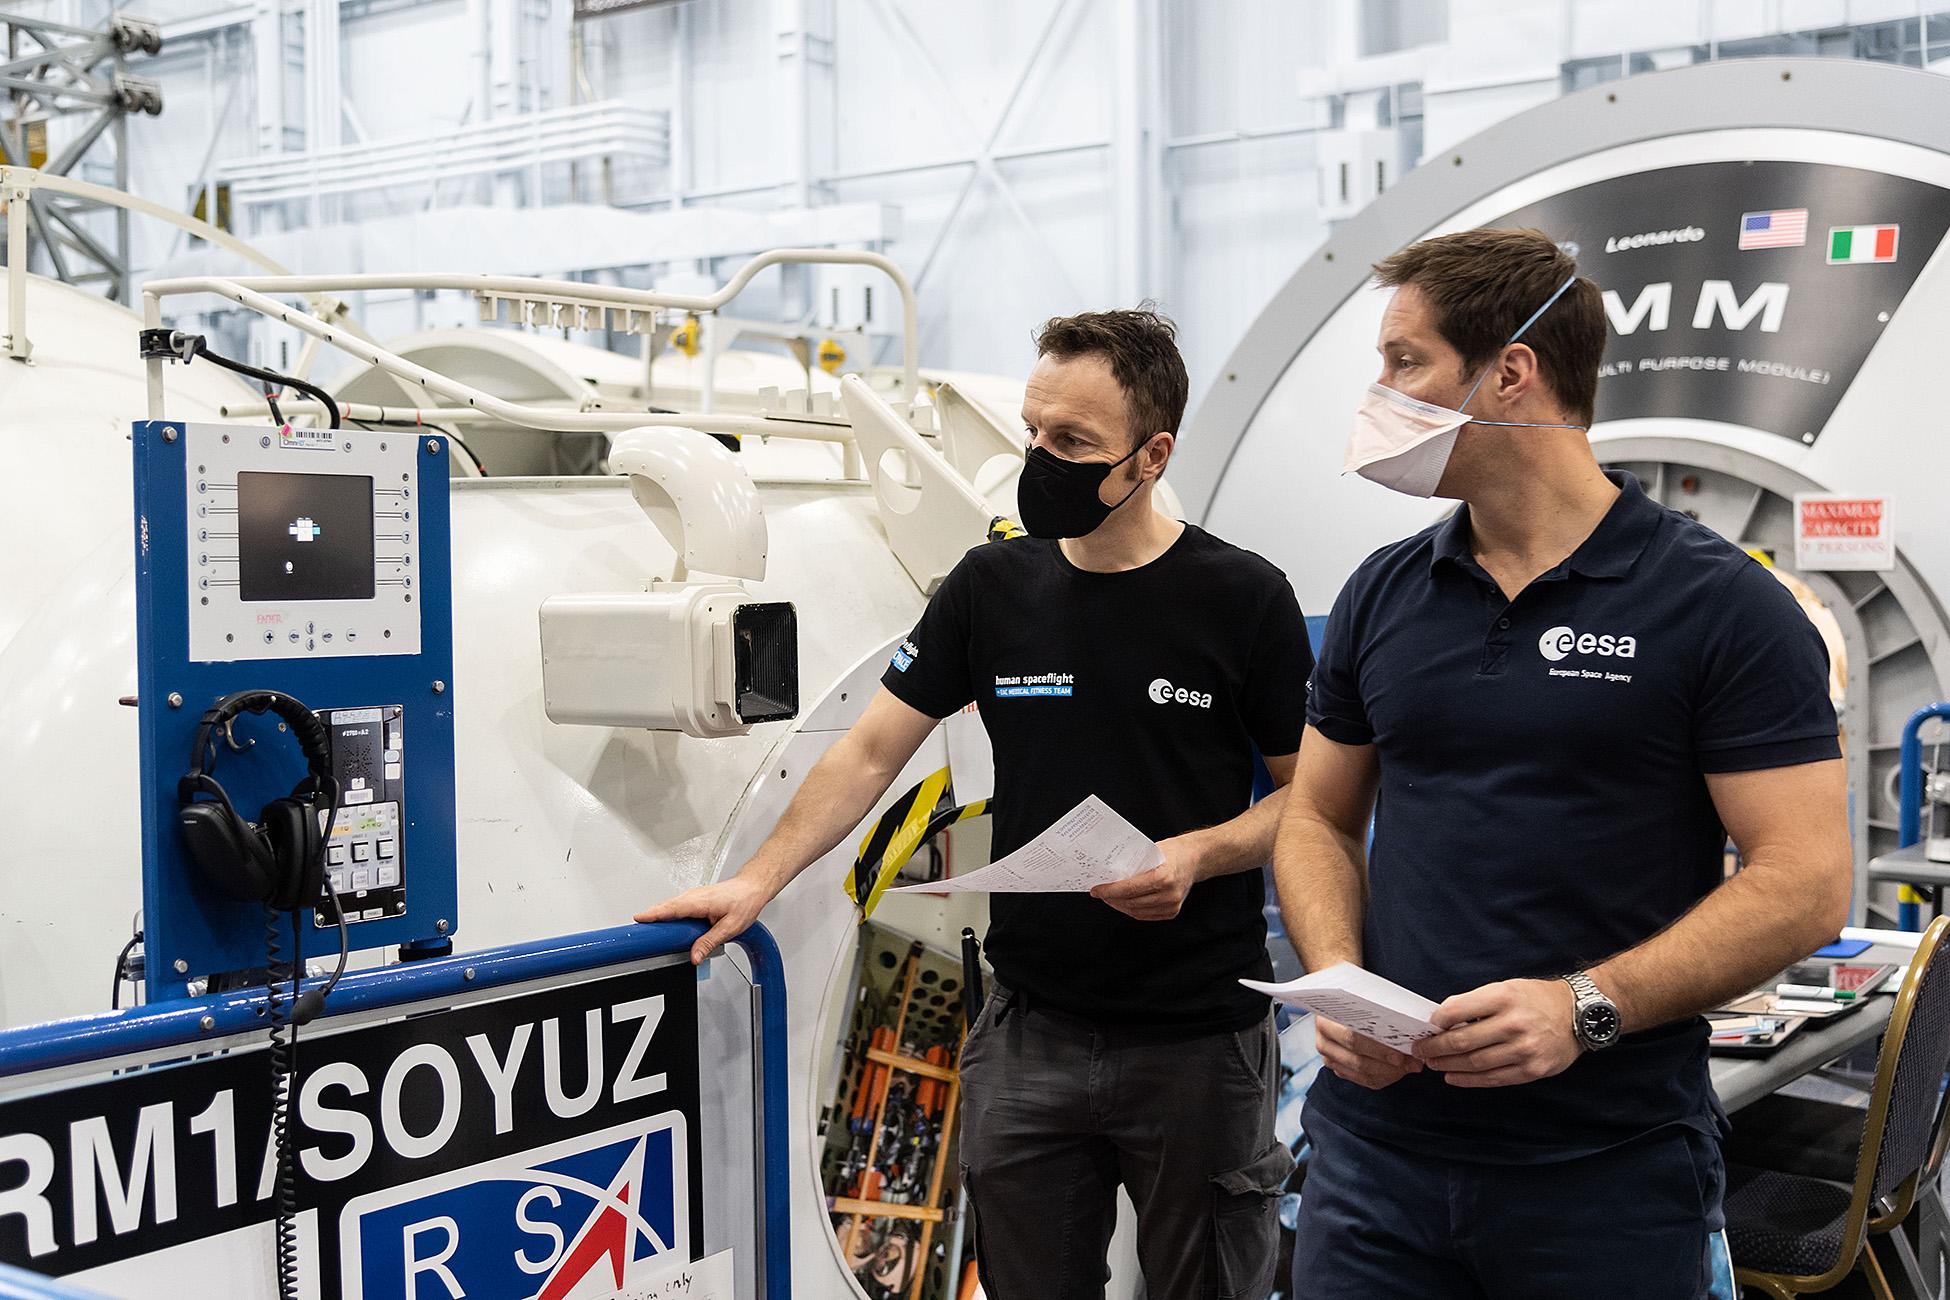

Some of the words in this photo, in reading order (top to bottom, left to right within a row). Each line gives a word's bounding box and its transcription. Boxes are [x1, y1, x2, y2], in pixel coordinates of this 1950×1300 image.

[1605, 225, 1706, 254] Leonardo
[1638, 355, 1730, 372] PURPOSE
[1801, 502, 1882, 518] MAXIMUM
[1801, 520, 1880, 537] CAPACITY
[995, 675, 1021, 686] human
[1022, 672, 1075, 686] spaceflight
[1548, 668, 1580, 678] European
[1580, 669, 1603, 679] Space
[1604, 672, 1633, 683] Agency
[1053, 687, 1071, 695] TEAM
